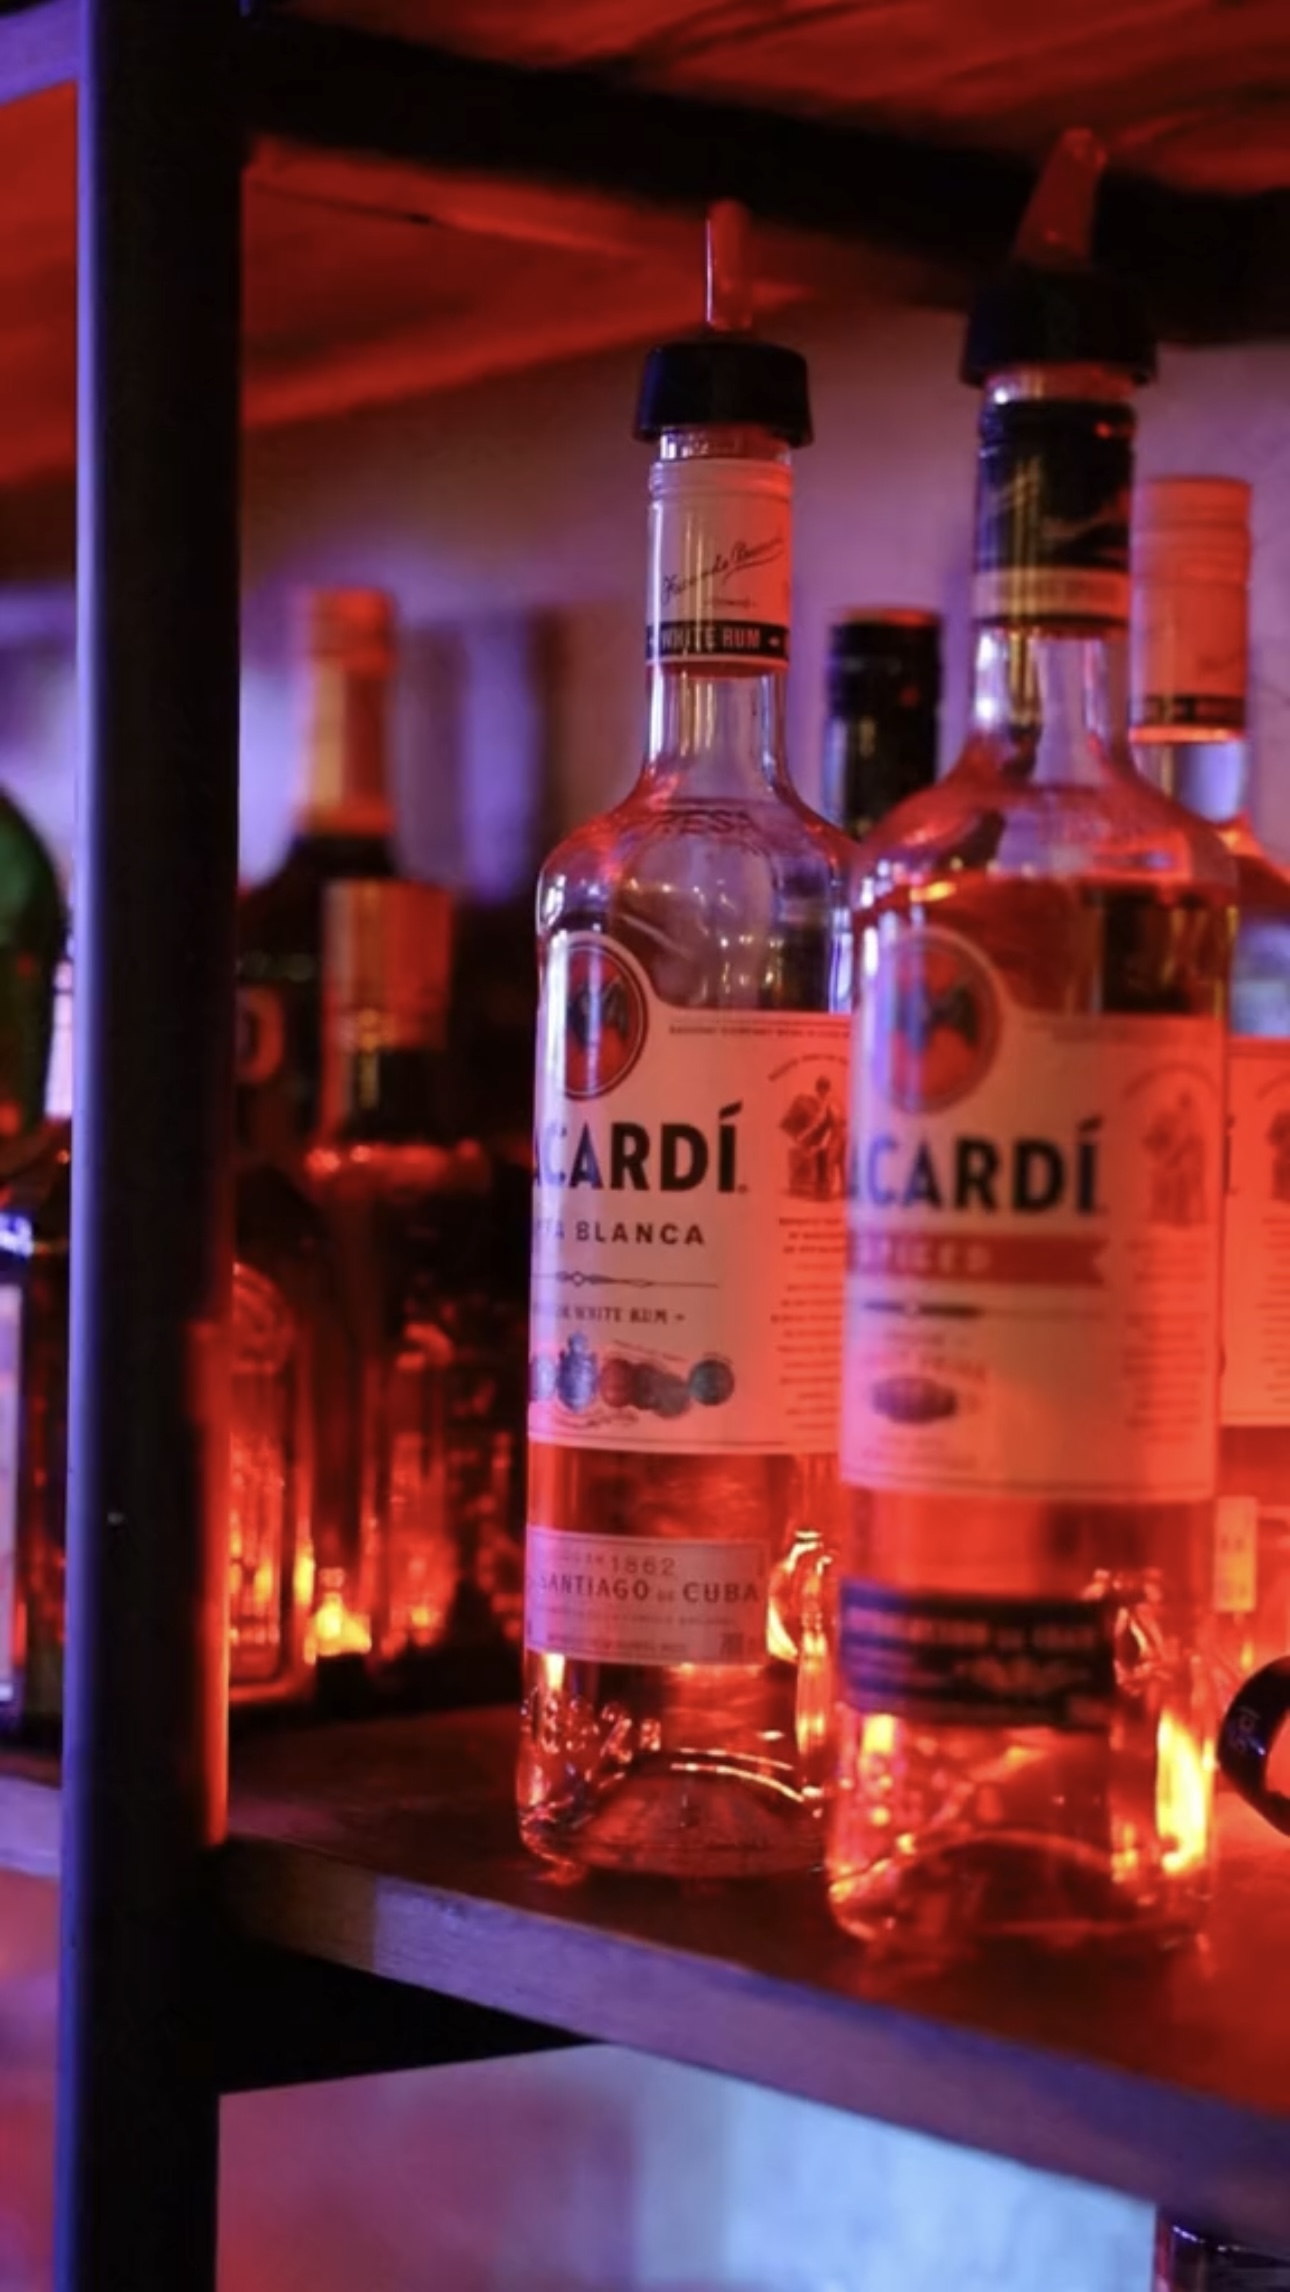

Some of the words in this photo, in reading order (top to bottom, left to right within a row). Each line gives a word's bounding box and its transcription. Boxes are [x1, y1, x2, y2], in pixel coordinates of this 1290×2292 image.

[661, 626, 716, 649] WHITE
[722, 627, 760, 647] RUM
[848, 1115, 1103, 1214] CARDÍ
[574, 1219, 706, 1247] BLANCA
[630, 1307, 668, 1324] RUM
[611, 1555, 676, 1577] 1862
[540, 1573, 650, 1601] SANTIAGO
[682, 1581, 759, 1604] CUBA
